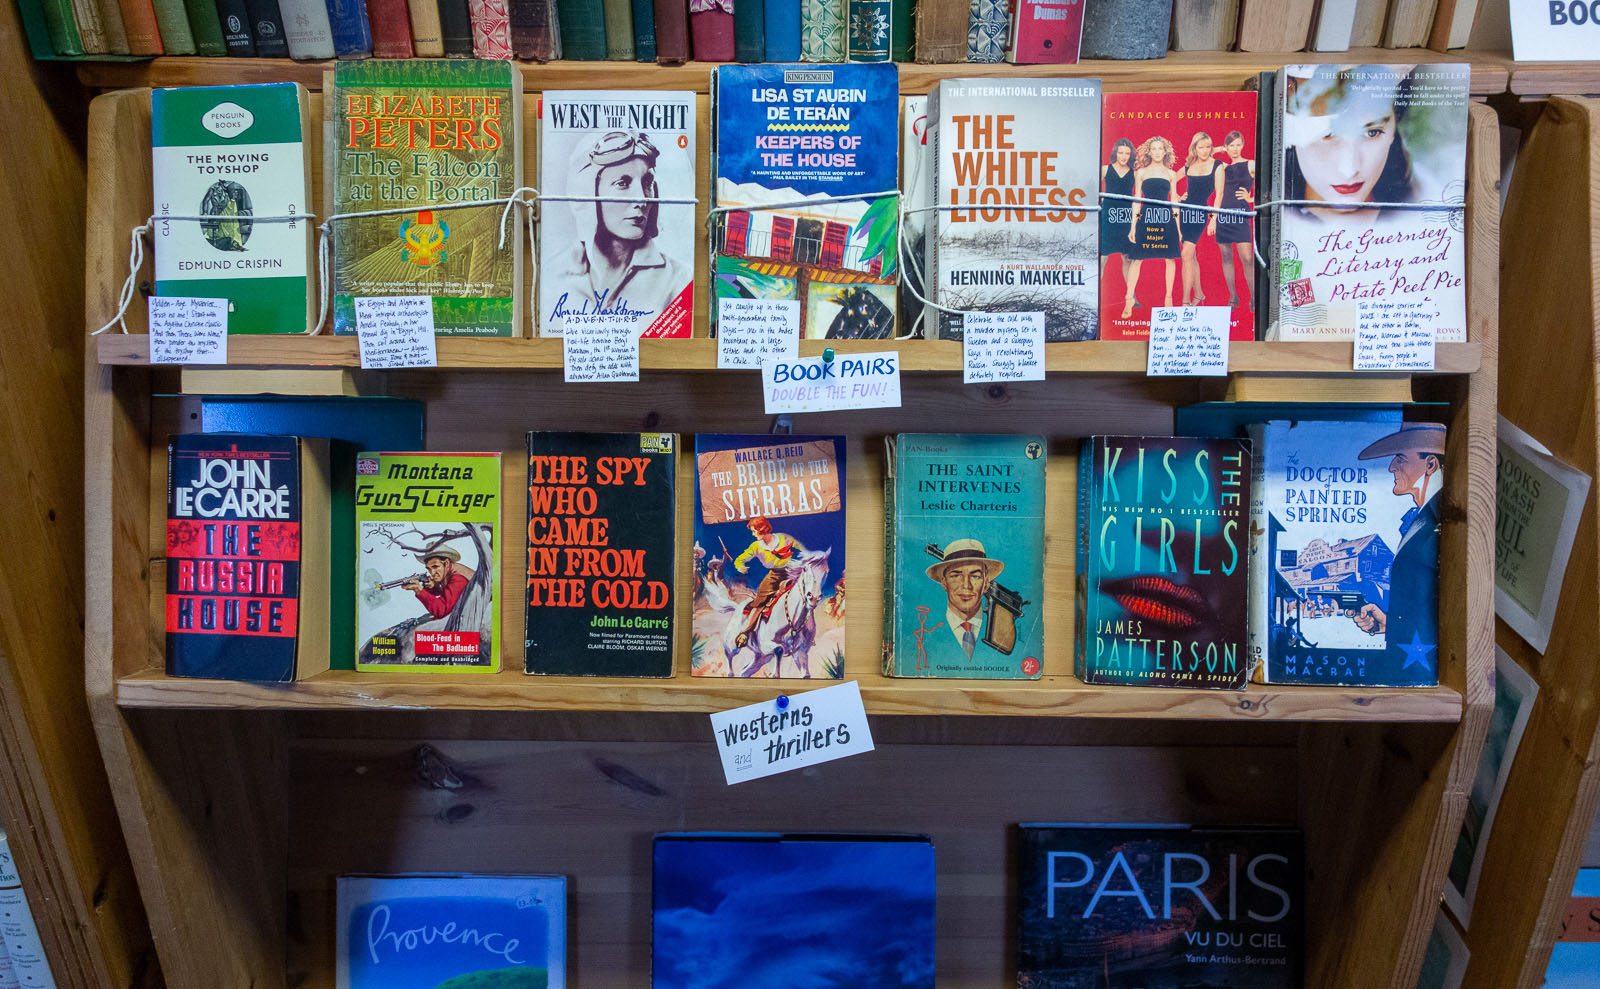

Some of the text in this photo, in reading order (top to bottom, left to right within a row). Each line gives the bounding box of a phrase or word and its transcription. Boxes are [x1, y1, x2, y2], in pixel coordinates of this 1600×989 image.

[1033, 5, 1068, 20] Dumas
[1320, 72, 1467, 81] THE INTERNATIONAL BESTSELLER
[751, 88, 866, 103] LISA ST AUBIN
[948, 87, 1095, 97] THE INTERNATIONAL BESTSELLER
[346, 95, 502, 116] ELIZABETH
[767, 104, 850, 121] DE TERÁN
[211, 112, 245, 120] PENGUIN
[550, 103, 689, 130] WEST WITH THE NIGHT
[1110, 111, 1246, 120] CANDACE BUSHNELL
[215, 121, 241, 129] BOOKS
[346, 117, 502, 150] PETERS
[951, 115, 1015, 150] THE
[755, 135, 862, 150] KEEPERS OF
[187, 153, 269, 164] THE MOVING
[346, 152, 500, 178] The Falcon
[761, 153, 856, 168] THE HOUSE
[197, 164, 260, 174] TOYSHOP
[951, 151, 1059, 187] WHITE
[351, 179, 498, 201] at the Portal
[950, 187, 1088, 224] LIONESS
[288, 203, 296, 230] CRME
[1108, 207, 1246, 224] SEX AND THE CITY
[1317, 229, 1353, 253] The
[1355, 227, 1448, 254] Guernsey
[178, 259, 282, 271] EDMUND CRISPIN
[1315, 236, 1451, 281] Literary and
[950, 270, 1086, 286] HENNING MANKELL
[1329, 269, 1462, 302] Potato Peel Pie
[453, 326, 499, 334] Amelia Peabody
[773, 358, 896, 384] BOOK PAIRS
[772, 382, 888, 402] DOUBLE THE FUN!
[641, 436, 659, 448] PAN
[734, 448, 773, 463] WALLACE
[1287, 450, 1300, 465] The
[191, 458, 271, 489] JOHN
[387, 463, 473, 480] Montana
[530, 456, 652, 486] THE SPY
[711, 459, 829, 488] THE BRIDE OF THE
[926, 463, 1014, 477] THE SAINT
[1102, 447, 1209, 505] KISS
[1221, 451, 1242, 507] THE
[1286, 466, 1368, 484] DOCTOR
[918, 480, 1021, 494] INTERVENES
[176, 484, 290, 519] LE CARRÉ
[529, 486, 598, 515] WHO
[722, 478, 824, 521] SIERRAS
[921, 500, 1018, 512] Leslie Charteris
[1285, 489, 1368, 506] PAINTED
[1180, 508, 1240, 517] BESTSELLER
[1285, 507, 1368, 524] SPRINGS
[203, 524, 262, 556] THE
[527, 517, 609, 546] CAME
[1100, 514, 1238, 577] GIRLS
[527, 547, 647, 578] IN FROM
[178, 560, 285, 594] RUSSIA
[527, 578, 669, 610] THE COLD
[177, 597, 284, 633] HOUSE
[590, 615, 669, 629] John Le Carré
[1096, 619, 1143, 636] JAMES
[372, 636, 396, 645] William
[416, 633, 461, 642] Blood-Feud in
[372, 647, 396, 656] Hopson
[432, 643, 479, 653] The Badlands!
[1095, 636, 1237, 673] PATTERSON
[415, 656, 438, 664] Complete
[936, 664, 962, 672] Originally
[963, 664, 983, 672] entitled
[1285, 655, 1366, 667] MASON
[1095, 669, 1122, 677] AUTHOR
[1138, 671, 1167, 679] ALONG
[1171, 672, 1193, 680] CAME
[1207, 674, 1238, 682] SPIDER
[1285, 667, 1366, 678] MACRAE
[718, 705, 814, 748] Westerns
[763, 723, 852, 765] thrillers
[734, 747, 753, 765] and
[1045, 850, 1292, 923] PARIS
[366, 904, 527, 964] Provence
[1184, 930, 1287, 949] VU DU CIEL
[1185, 953, 1287, 966] Yann Arthus-Bertrand
